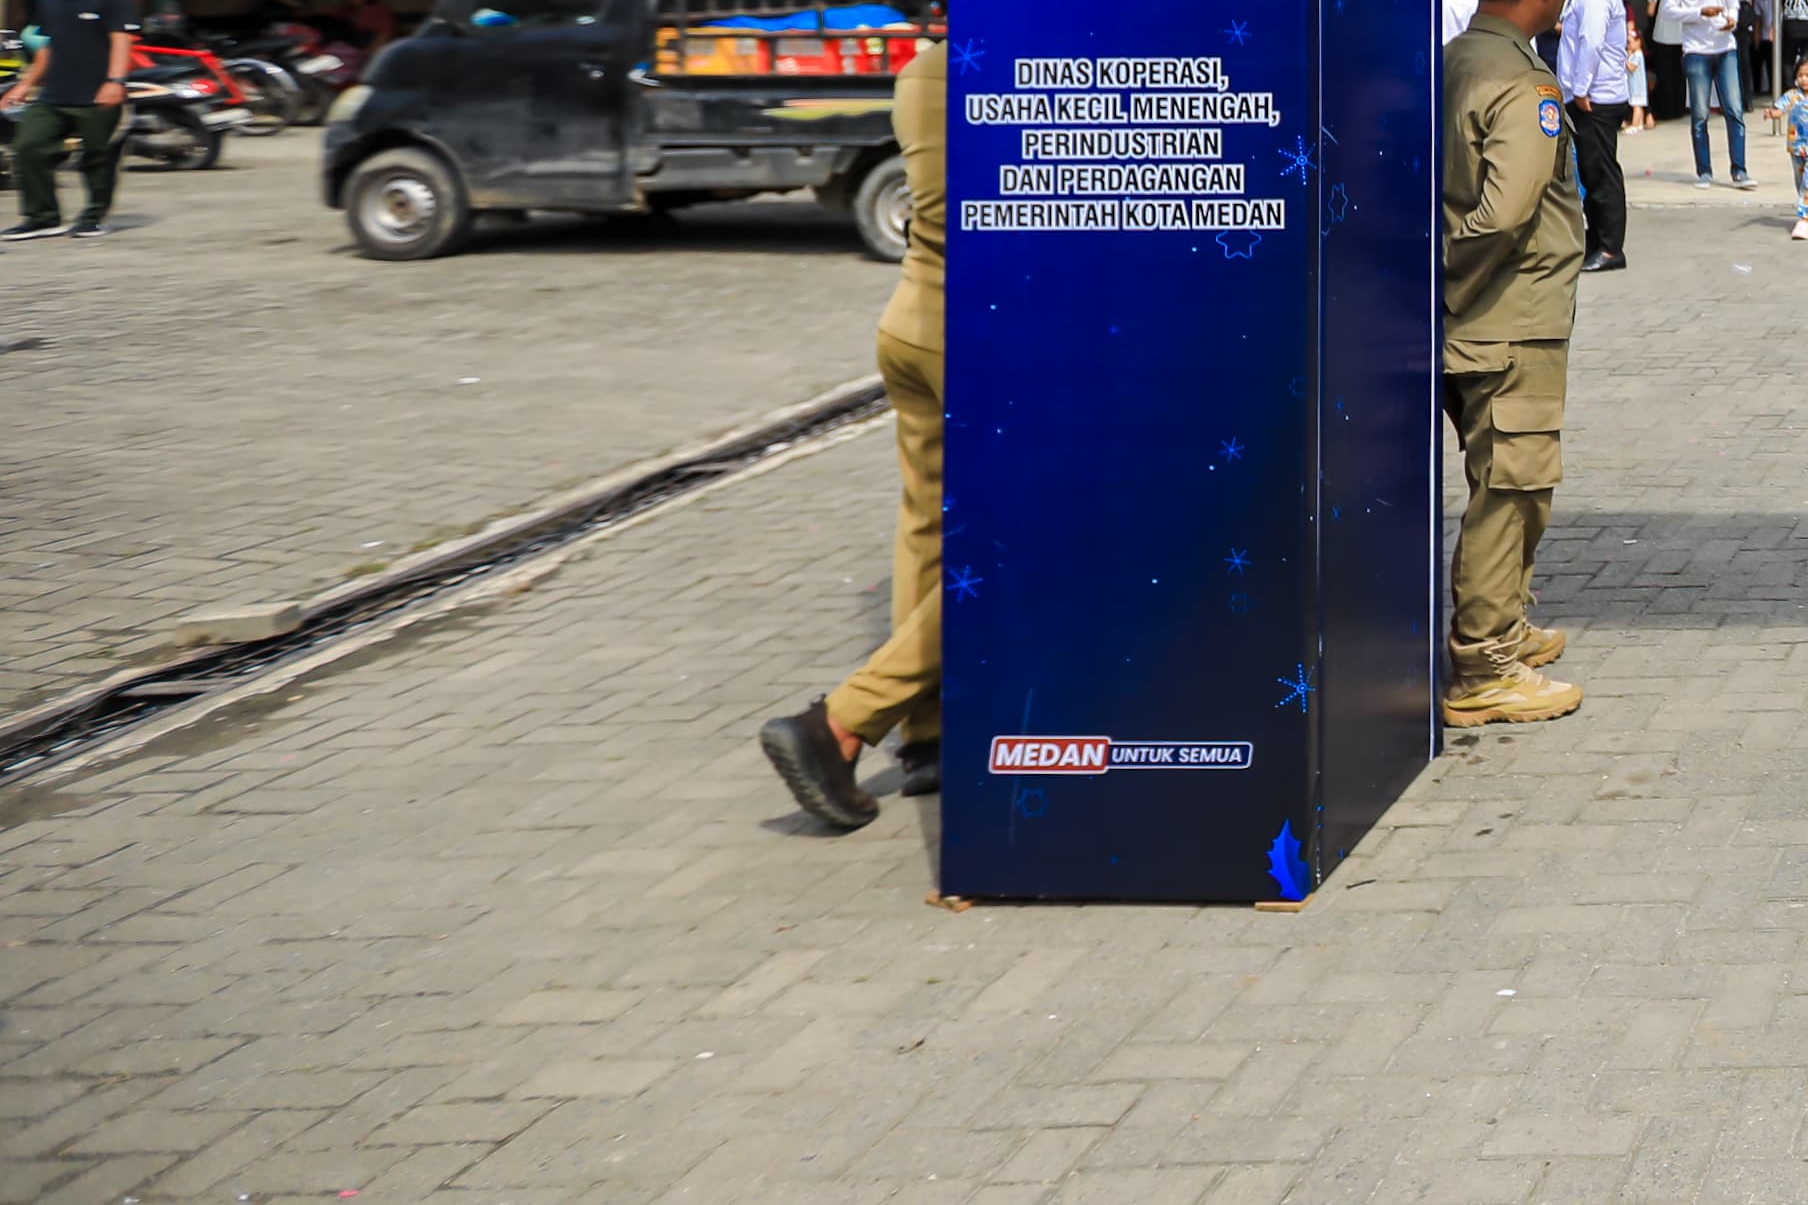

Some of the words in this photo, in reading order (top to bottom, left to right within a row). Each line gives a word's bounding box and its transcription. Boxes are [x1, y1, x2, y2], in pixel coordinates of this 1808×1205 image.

[1015, 58, 1093, 88] DINAS
[1097, 57, 1228, 92] KOPERASI,
[966, 94, 1052, 124] USAHA
[1055, 93, 1128, 123] KECIL
[1130, 92, 1280, 127] MENENGAH,
[1022, 129, 1221, 159] PERINDUSTRIAN
[1000, 165, 1054, 194] DAN
[1057, 164, 1244, 194] PERDAGANGAN
[961, 200, 1119, 230] PEMERINTAH
[1122, 200, 1190, 230] KOTA
[1192, 199, 1285, 229] MEDAN
[994, 743, 1106, 766] MEDAN
[1112, 747, 1174, 763] UNTUK
[1178, 747, 1242, 764] SEMUA
